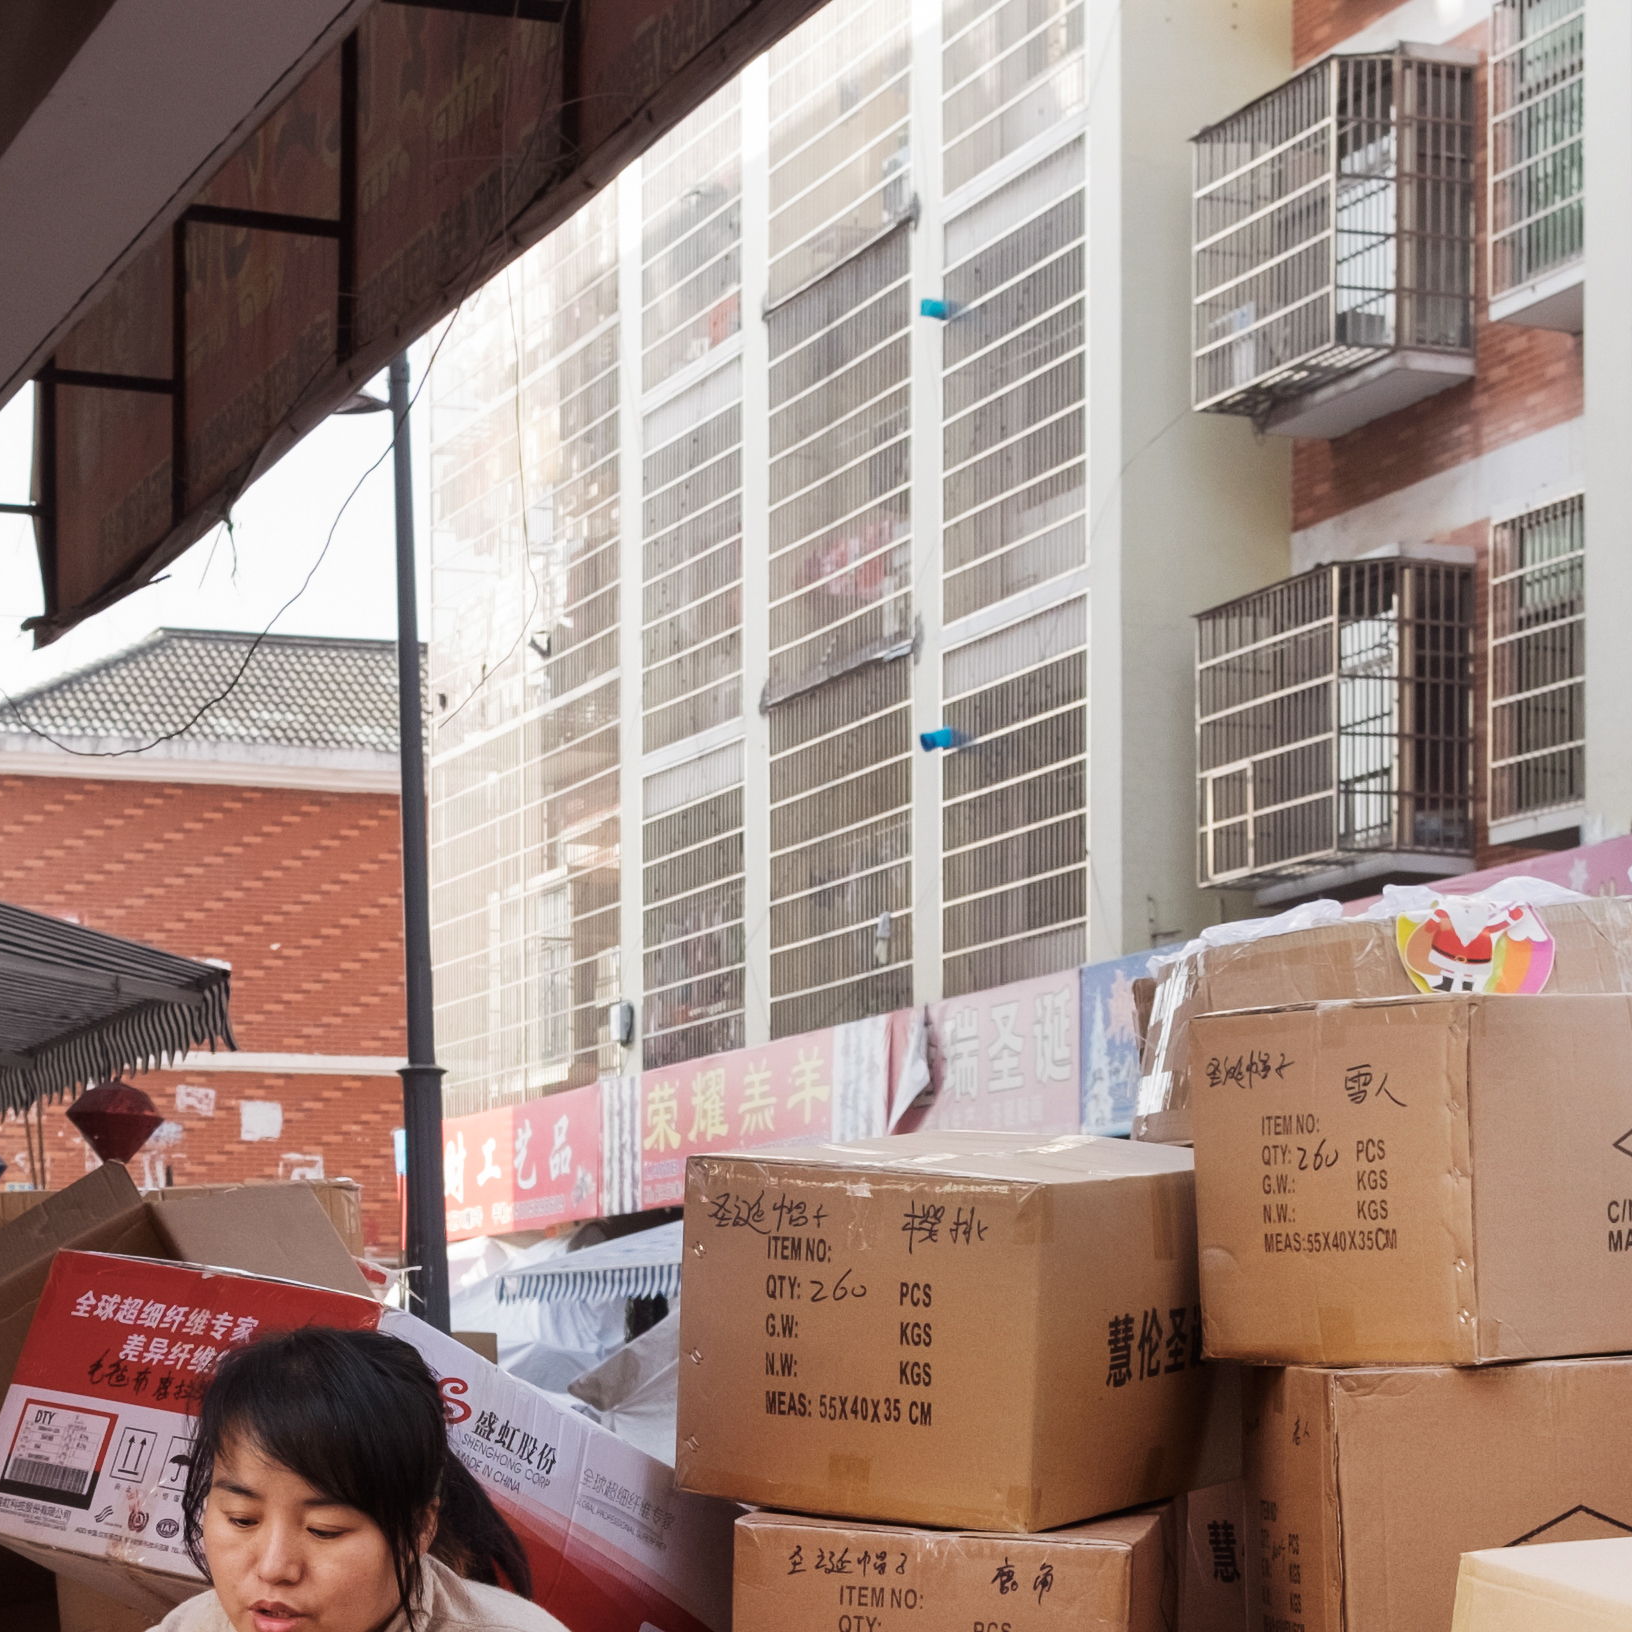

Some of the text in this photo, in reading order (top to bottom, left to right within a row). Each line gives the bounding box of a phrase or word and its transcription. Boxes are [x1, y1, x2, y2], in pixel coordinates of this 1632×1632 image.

[1261, 1113, 1320, 1136] ITEM NO:
[1261, 1144, 1292, 1166] QTY:
[1356, 1138, 1386, 1163] PCS
[1357, 1169, 1388, 1191] KGS
[1357, 1199, 1389, 1221] KGS
[767, 1235, 832, 1264] ITEM NO:
[766, 1268, 933, 1308] QTY: 260 PCS
[71, 1289, 260, 1344] 全球超细纤维专家
[765, 1313, 933, 1347] G.W: KGS
[119, 1333, 230, 1376] 差异纤维
[765, 1351, 933, 1387] N.W: KGS
[35, 1409, 57, 1425] DTY
[765, 1390, 933, 1426] MEAS: 55X40X35 CM
[470, 1409, 558, 1476] 盛虹股份
[456, 1446, 522, 1495] MADE IN CHINA
[461, 1432, 552, 1490] SHENGHONG CORP
[839, 1585, 925, 1610] ITEM NO:
